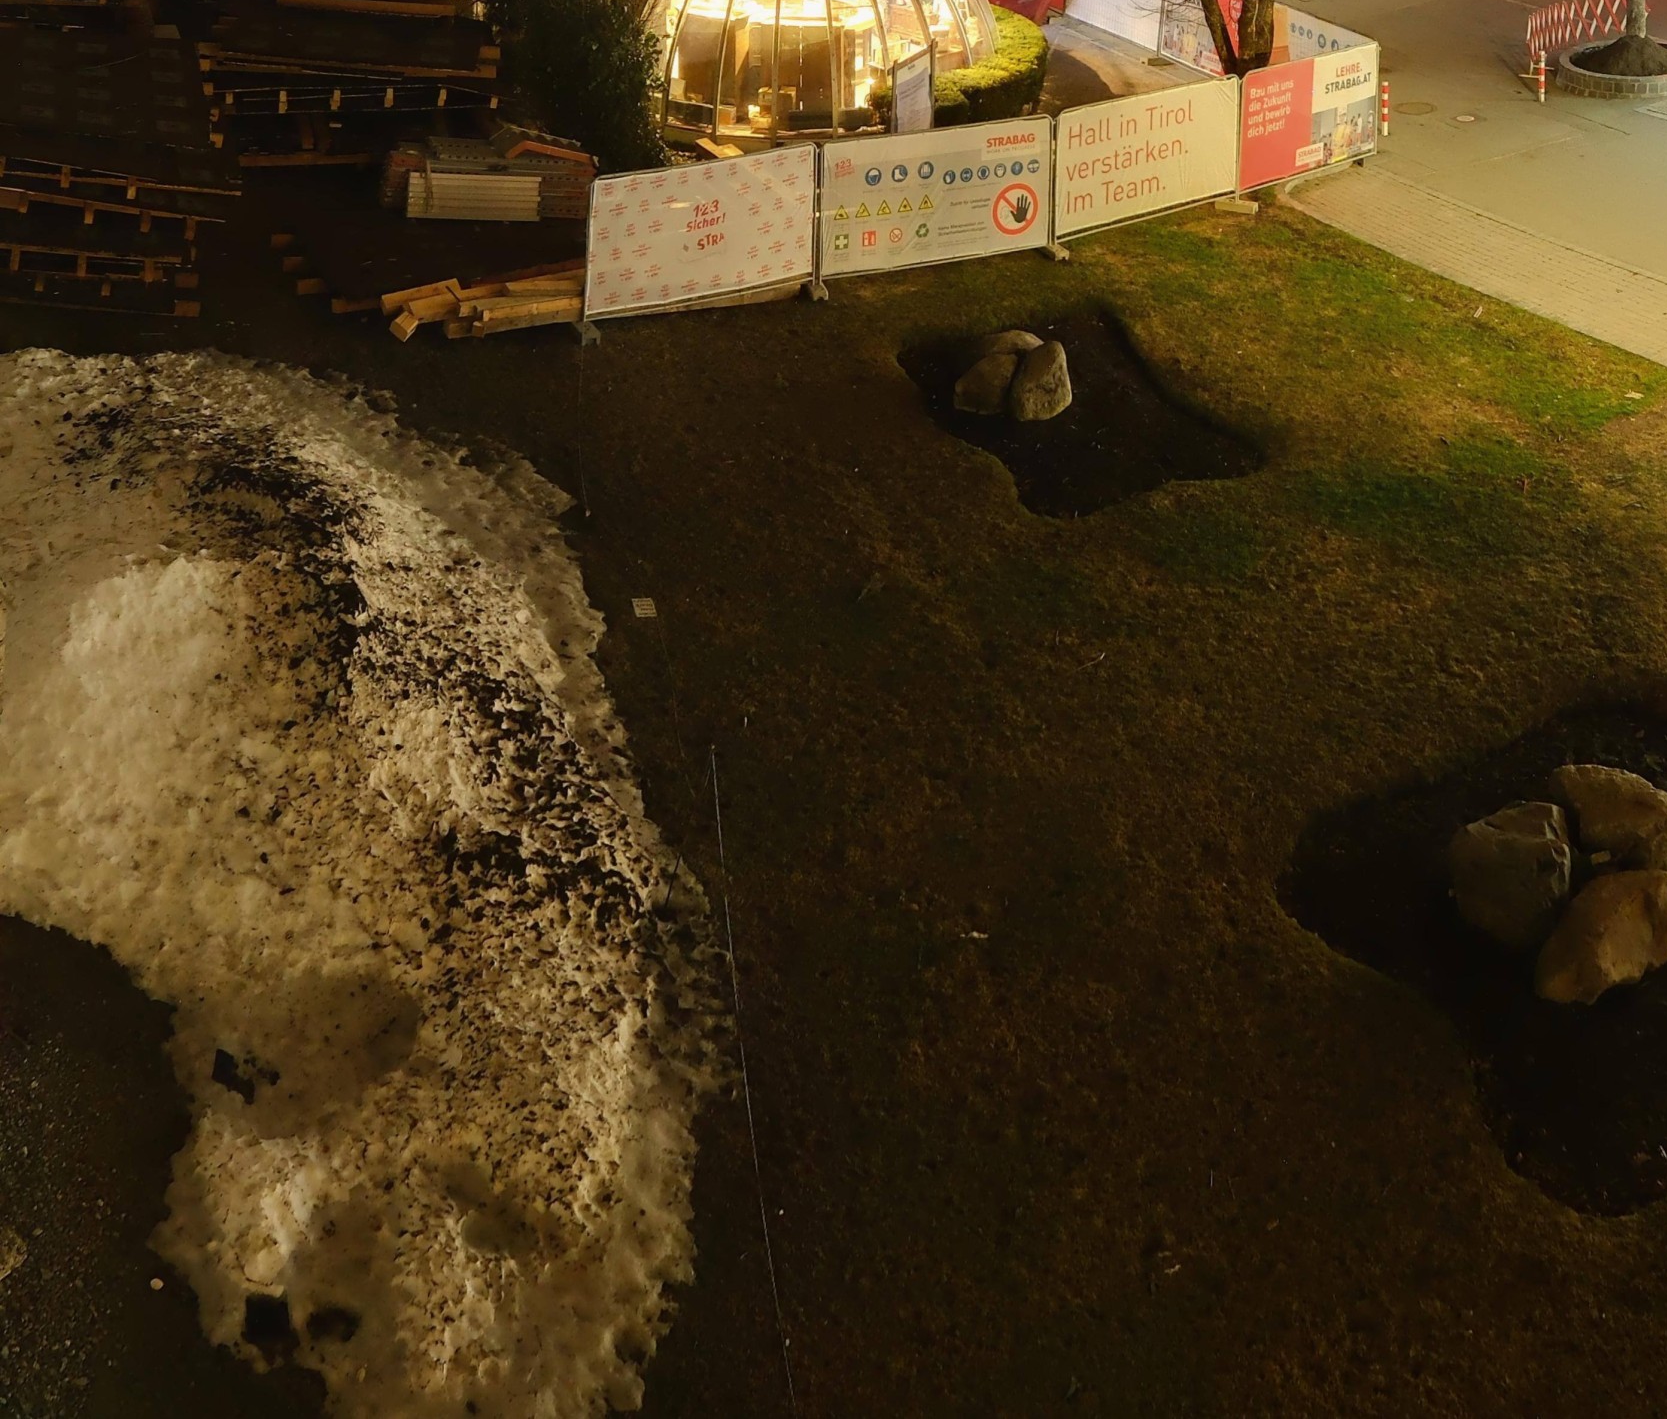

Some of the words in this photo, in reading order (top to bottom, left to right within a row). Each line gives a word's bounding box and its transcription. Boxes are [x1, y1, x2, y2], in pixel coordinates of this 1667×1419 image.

[1335, 62, 1363, 78] LEHRE.
[1250, 87, 1265, 99] Bau
[1267, 83, 1280, 94] mit
[1281, 80, 1294, 90] uns
[1325, 72, 1372, 94] STRABAG.AT
[1248, 101, 1261, 112] die
[1263, 92, 1292, 108] Zukunft
[1068, 117, 1111, 150] Hall
[1119, 114, 1137, 138] in
[1145, 99, 1194, 130] Tirol
[1248, 114, 1263, 125] und
[1265, 106, 1291, 120] bewirb
[1247, 125, 1264, 138] dich
[1264, 119, 1286, 135] jetzt!
[986, 133, 1036, 149] STRABAG
[1066, 139, 1189, 182] verstärken.
[1066, 191, 1093, 215] Im
[1101, 175, 1166, 205] Team.
[686, 213, 726, 233] Sicher!
